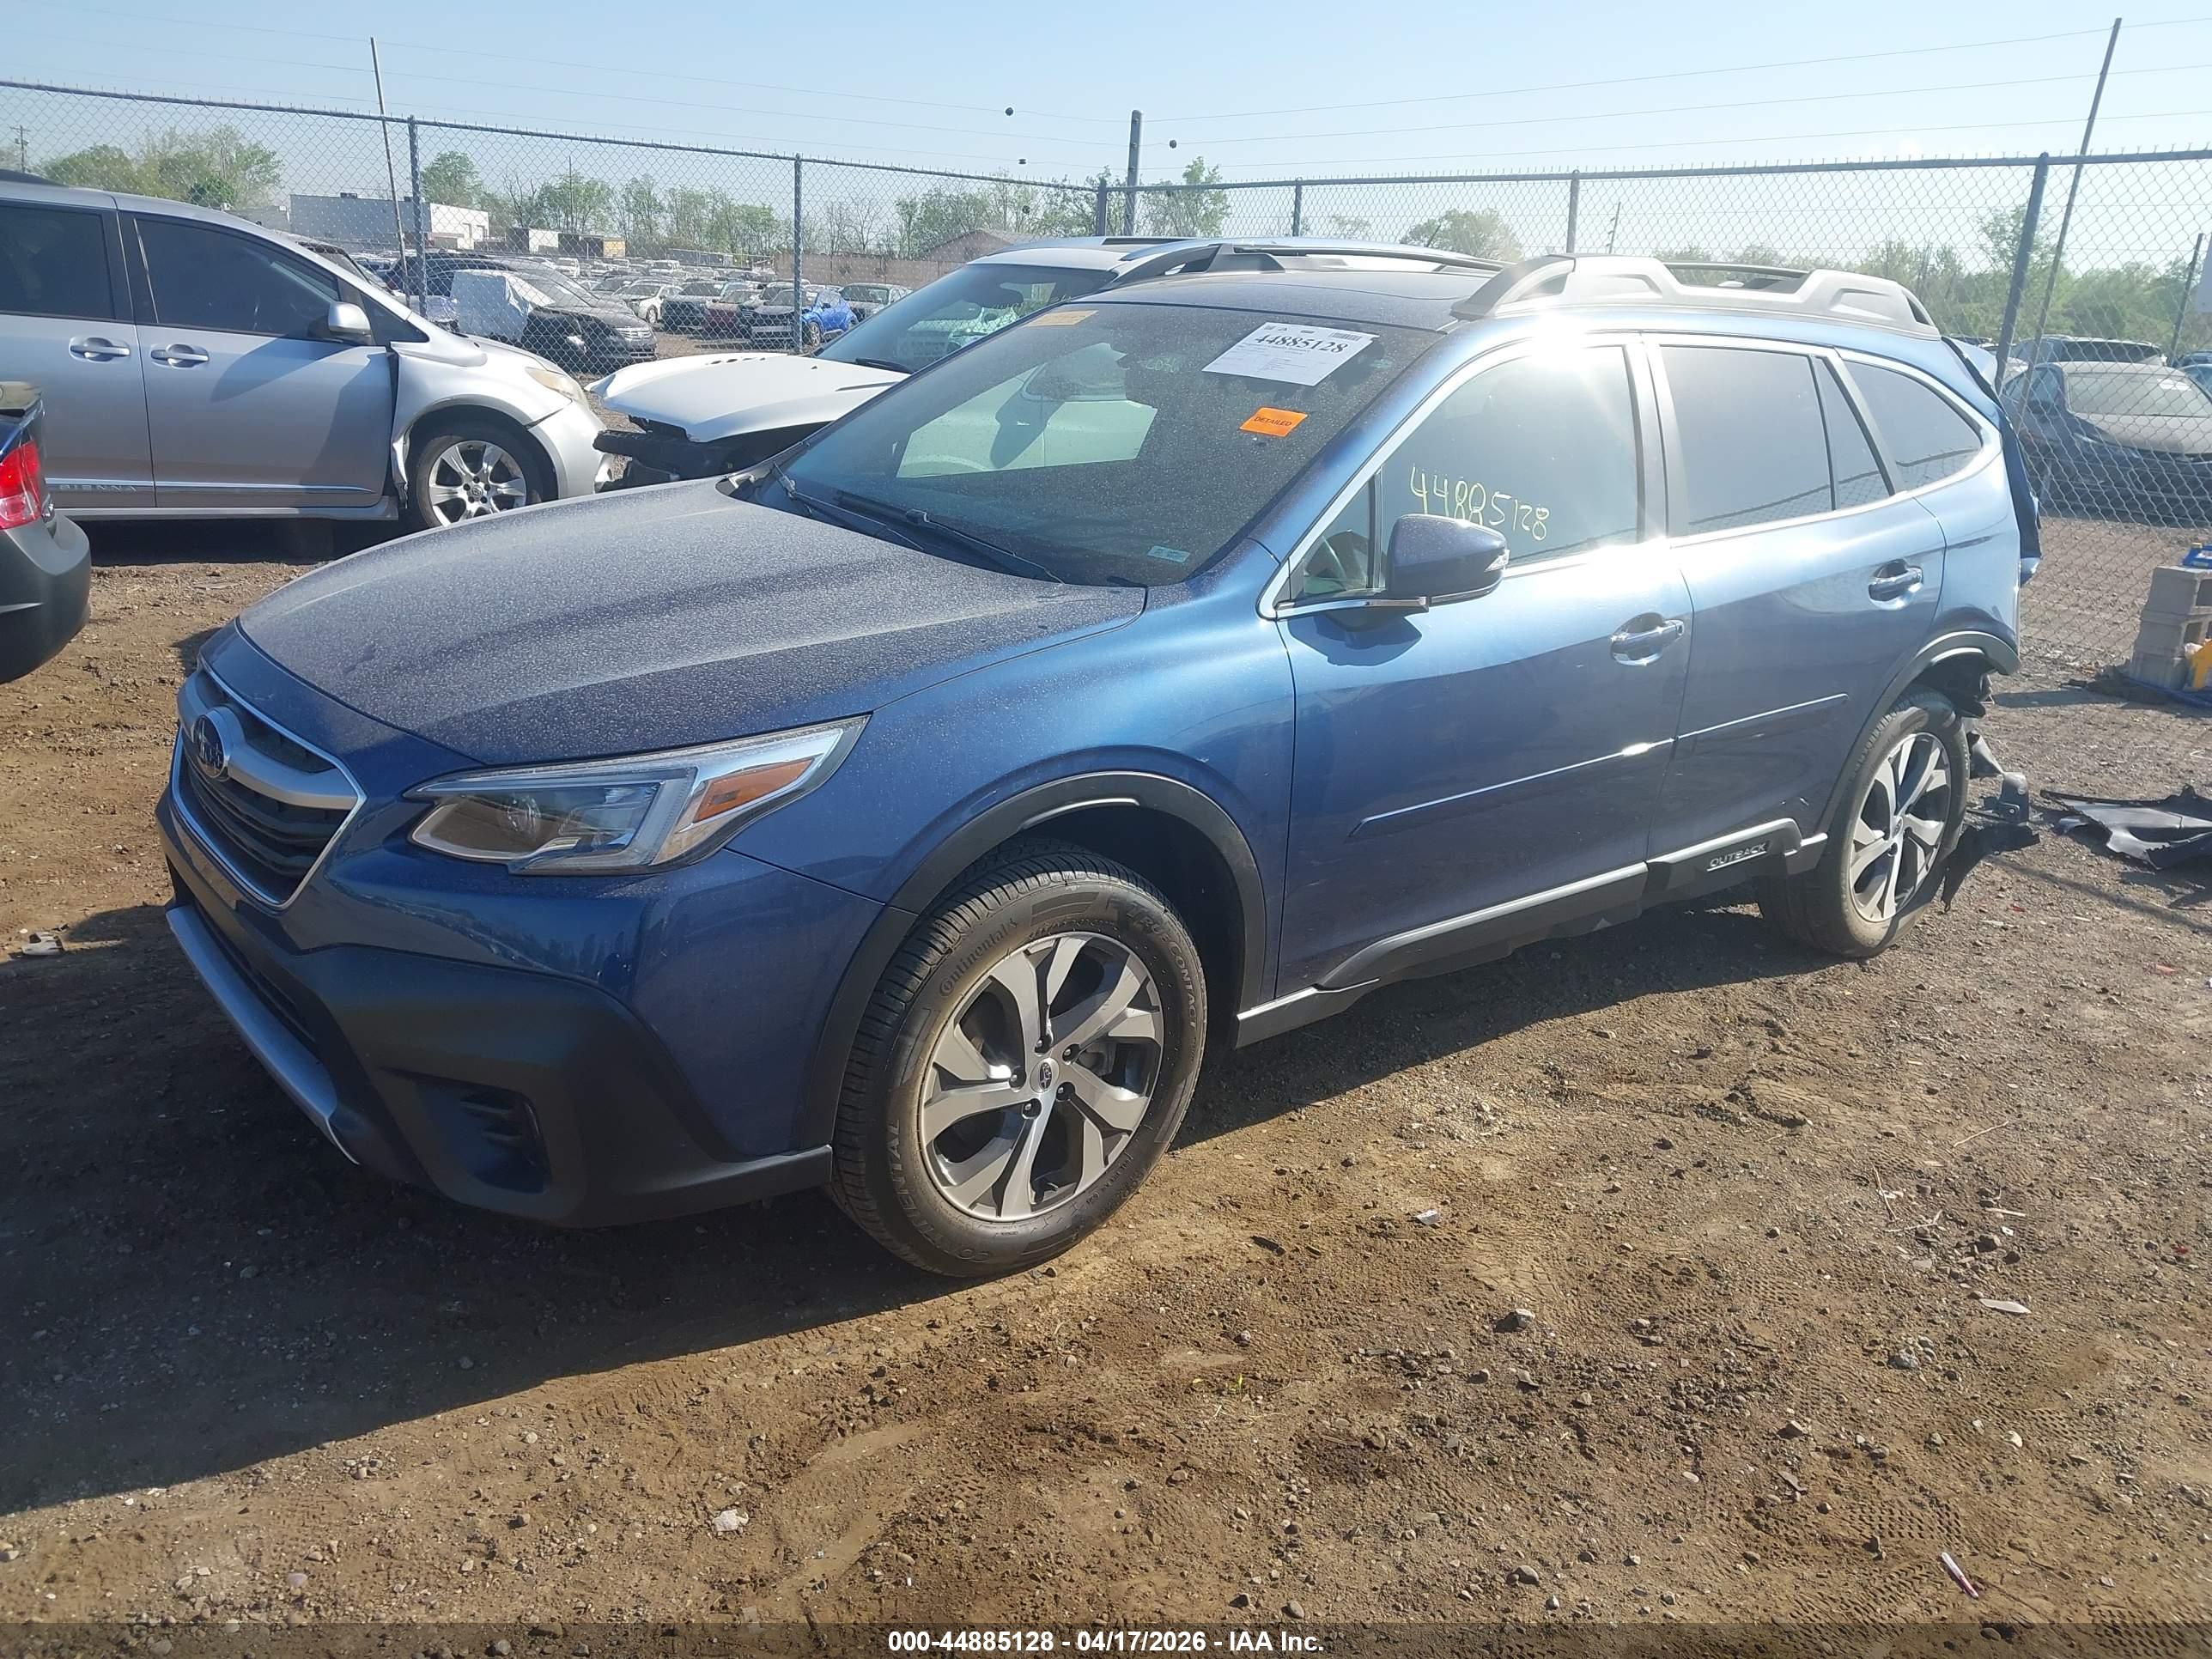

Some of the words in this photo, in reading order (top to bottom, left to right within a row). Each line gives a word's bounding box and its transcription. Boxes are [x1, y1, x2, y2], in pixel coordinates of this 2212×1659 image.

[1255, 333, 1349, 354] 44885128
[1254, 416, 1292, 427] DETAILED
[1410, 466, 1550, 541] 44885128
[1710, 842, 1766, 867] OUTBACK
